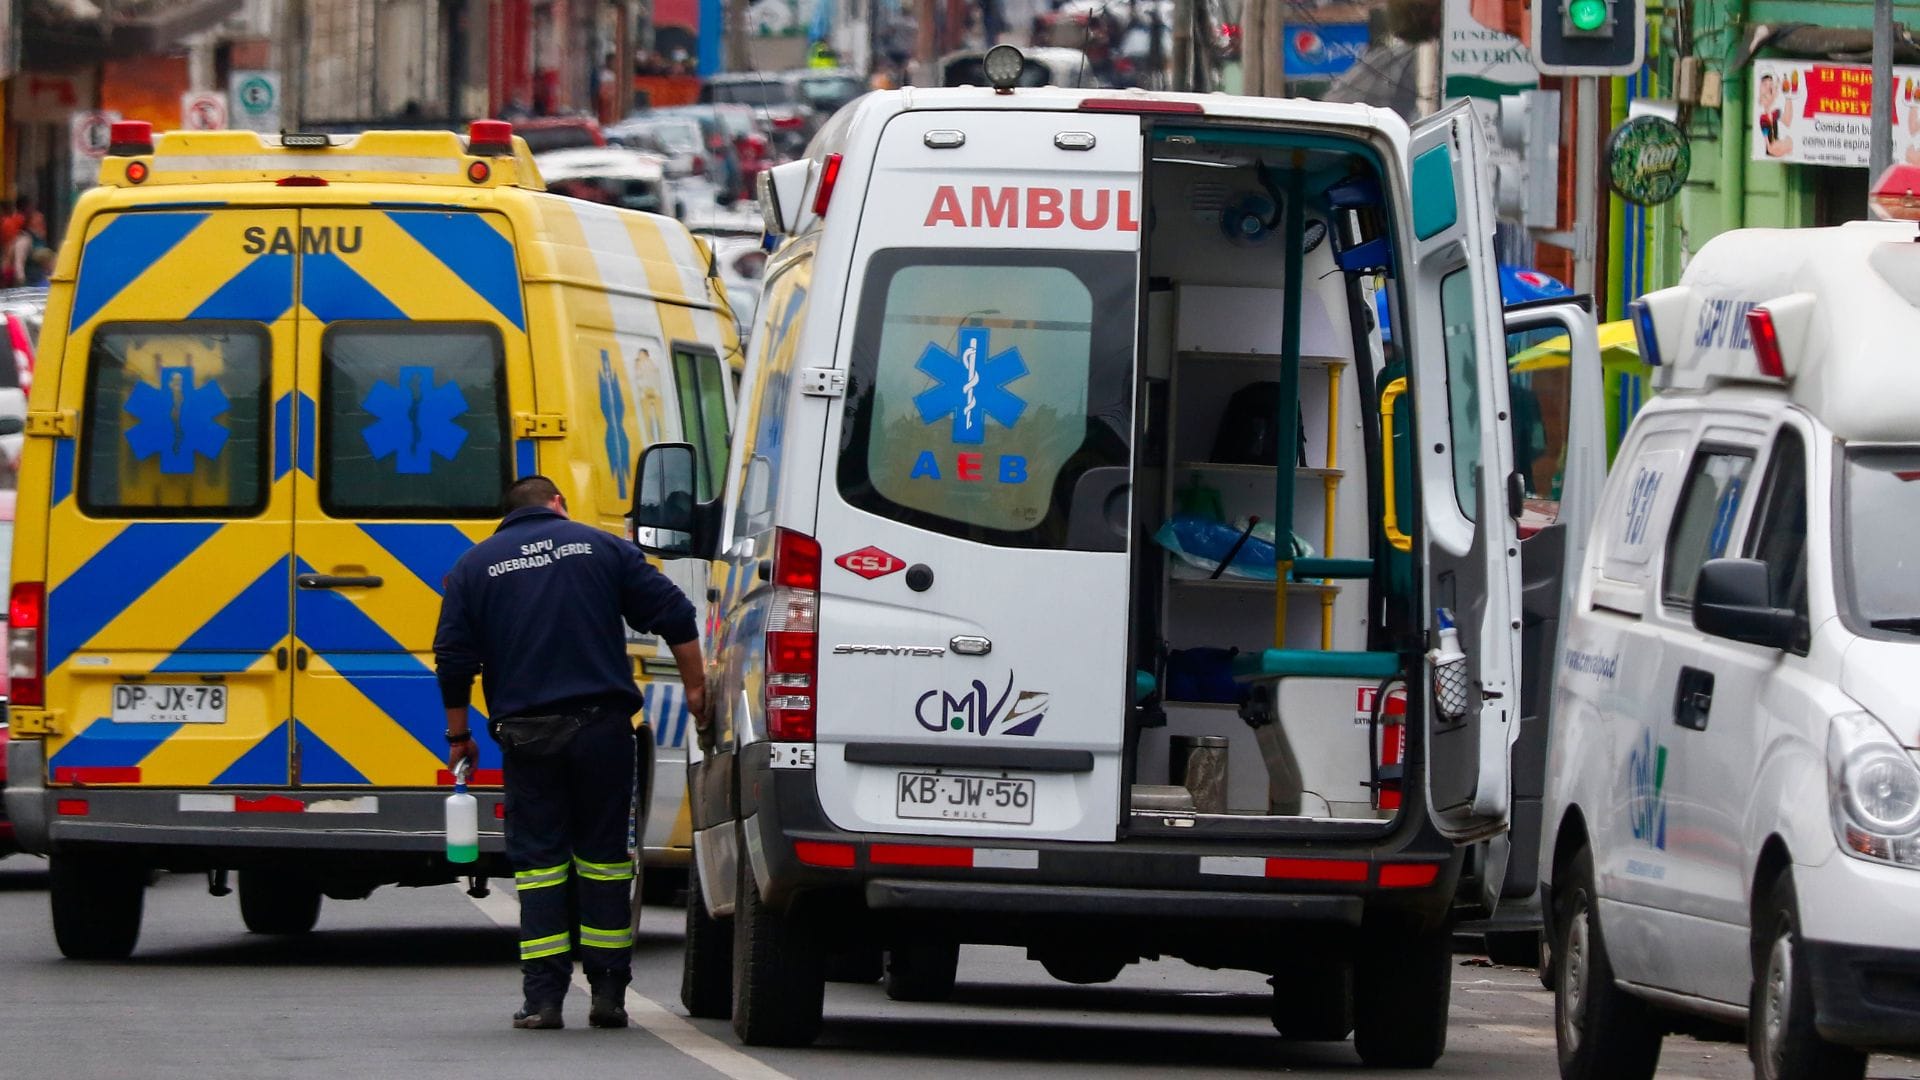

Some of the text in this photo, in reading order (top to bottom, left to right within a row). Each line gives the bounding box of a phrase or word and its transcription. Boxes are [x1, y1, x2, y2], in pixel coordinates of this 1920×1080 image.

[1842, 70, 1872, 86] Bajo
[1820, 98, 1871, 115] POPEY
[1815, 121, 1845, 133] Comida
[1847, 123, 1860, 135] tan
[1802, 135, 1826, 147] como
[1843, 138, 1870, 151] espina
[923, 185, 1139, 232] AMBUL
[243, 226, 363, 254] SAMU
[1695, 298, 1732, 348] SAPU
[520, 539, 554, 556] SAPU
[488, 542, 593, 577] QUEBRADA VERDE
[846, 555, 893, 572] CSJ
[832, 643, 945, 658] SPRINTER
[942, 809, 988, 819] CHILE
